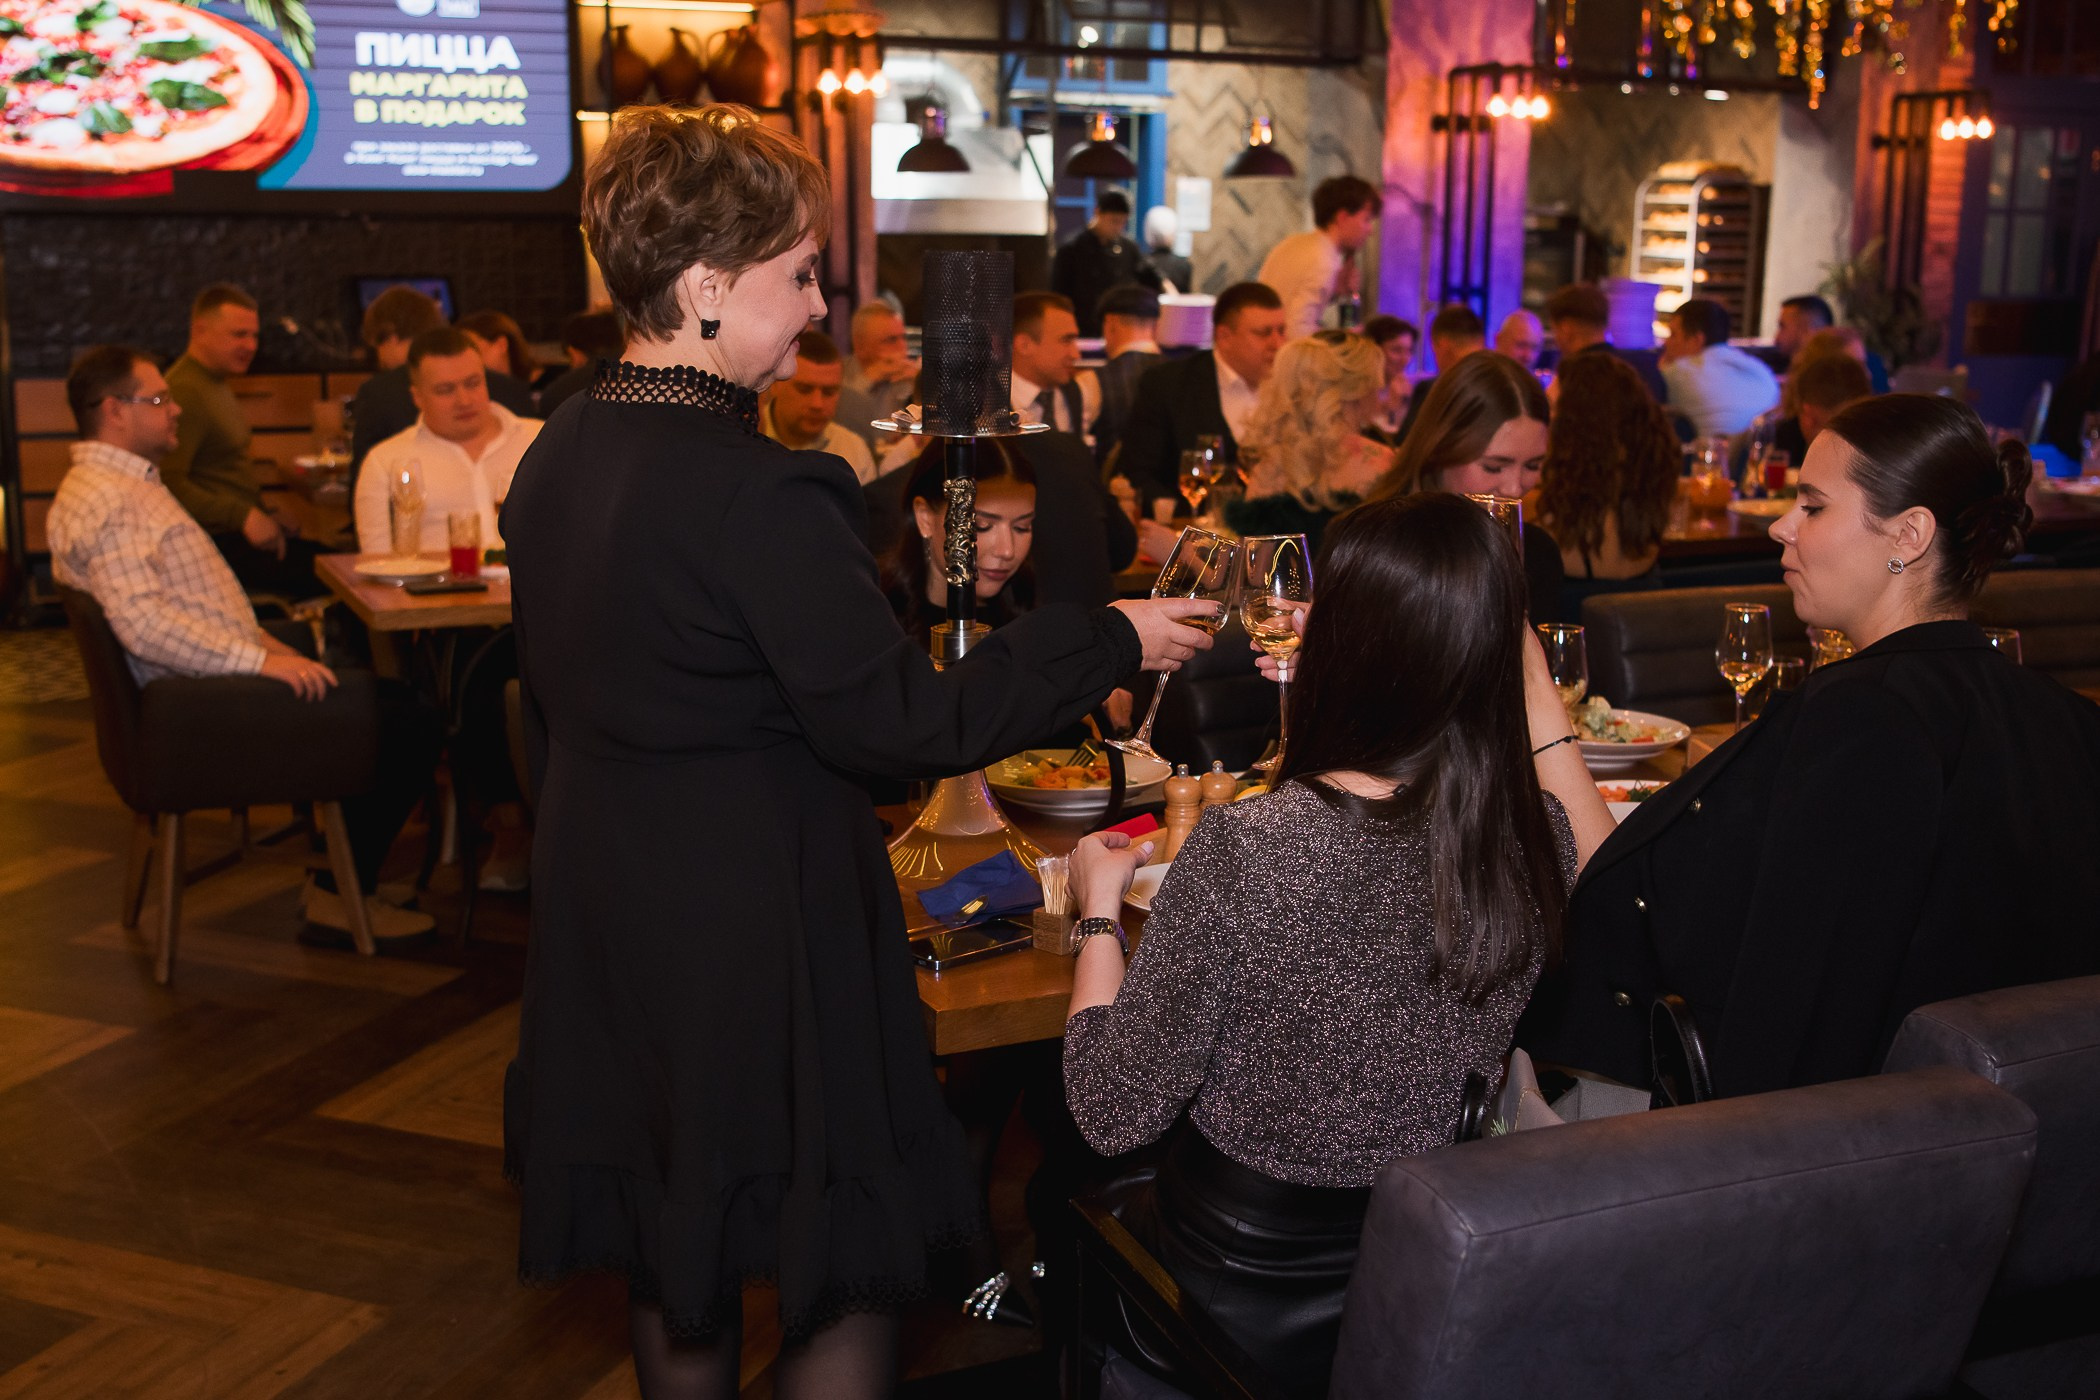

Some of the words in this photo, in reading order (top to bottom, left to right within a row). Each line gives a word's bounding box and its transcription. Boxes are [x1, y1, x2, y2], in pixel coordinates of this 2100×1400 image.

[355, 32, 521, 74] ПИЦЦА
[349, 71, 528, 99] МАРГАРИТА
[353, 98, 379, 123] В
[380, 99, 527, 128] ПОДАРОК
